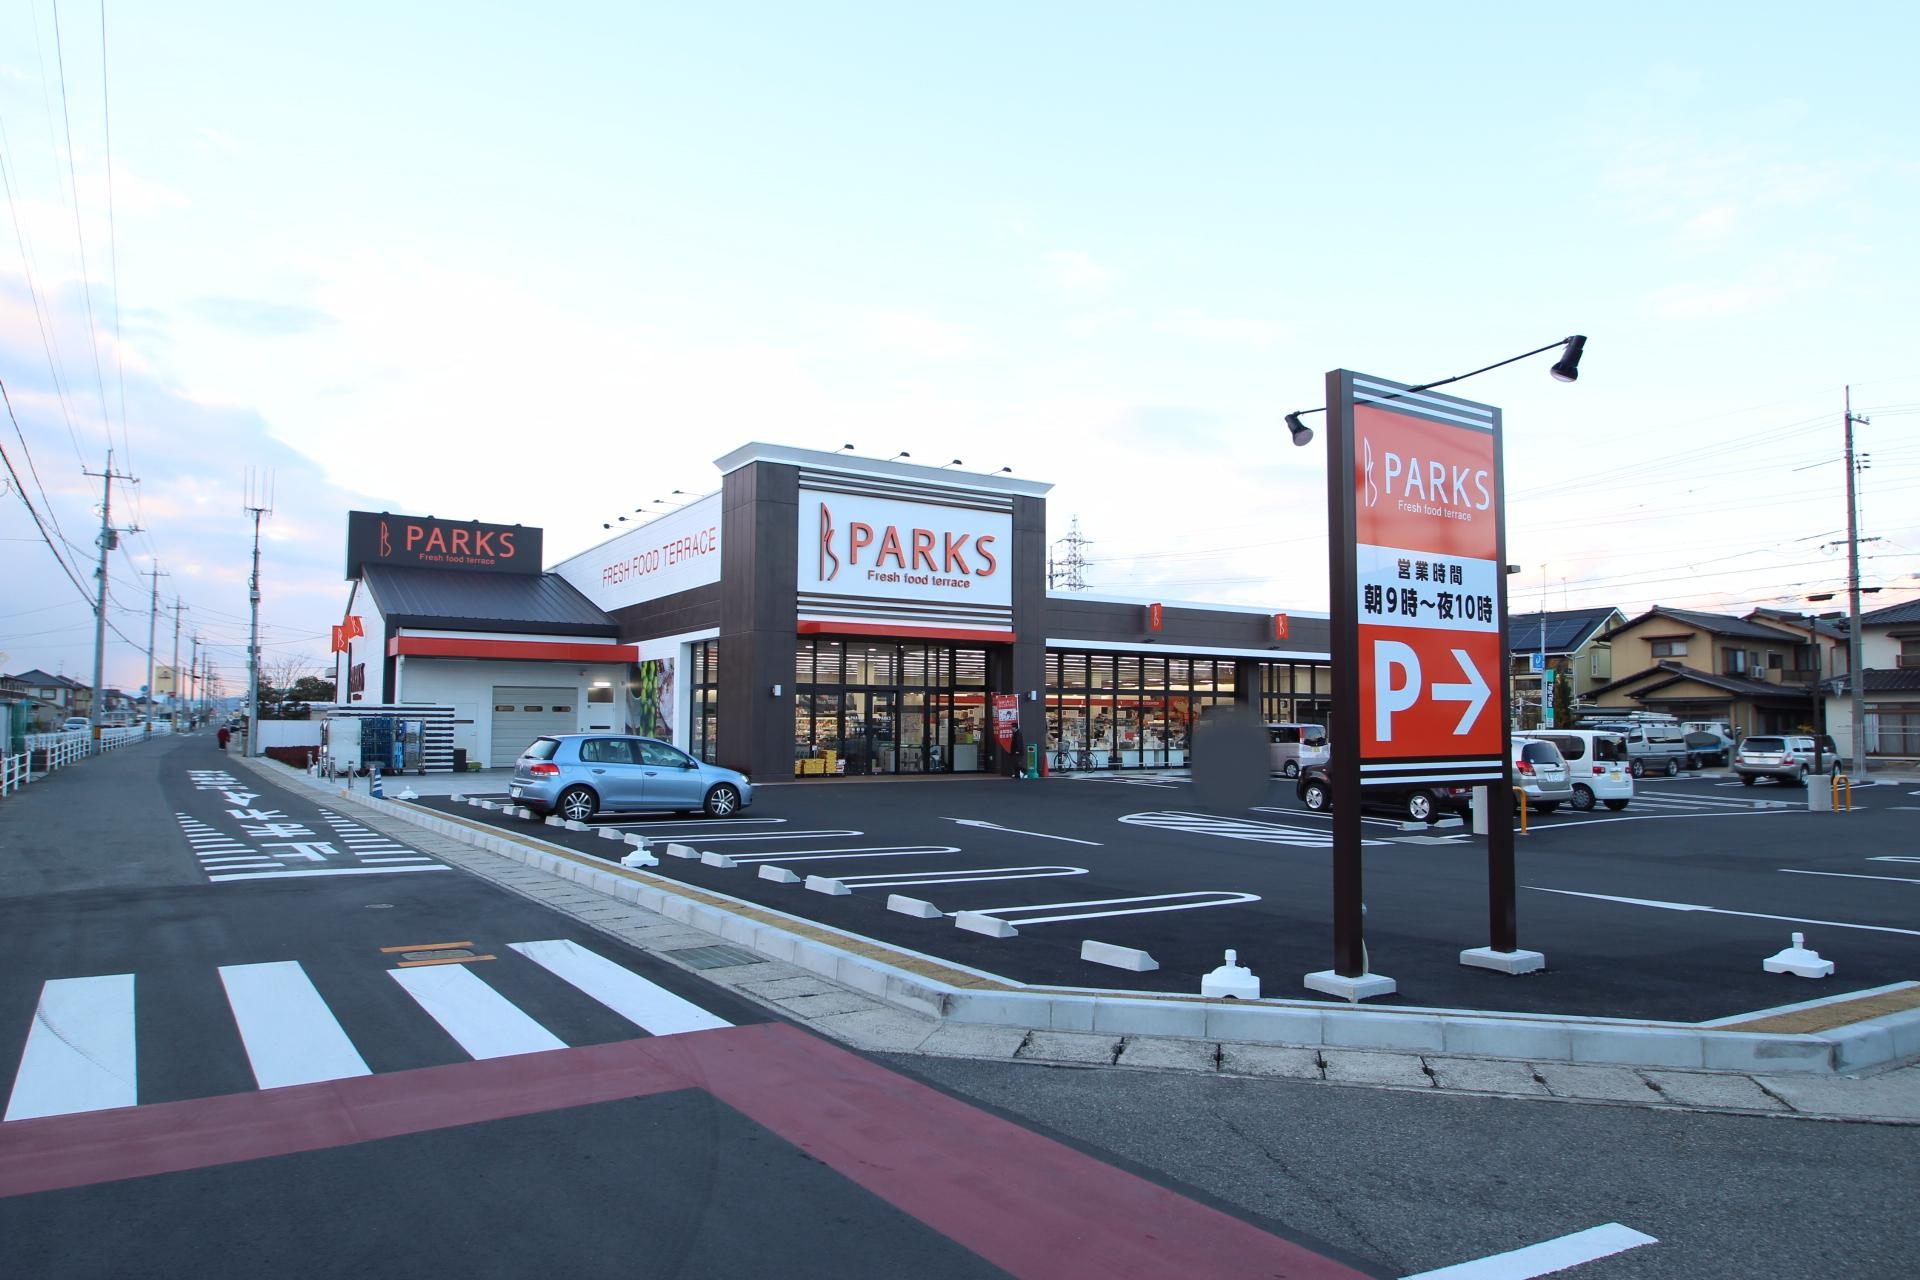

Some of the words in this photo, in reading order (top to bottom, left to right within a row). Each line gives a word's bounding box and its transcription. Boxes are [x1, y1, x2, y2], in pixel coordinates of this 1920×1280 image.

[1385, 451, 1490, 511] PARKS
[1398, 500, 1422, 514] Fresh
[1424, 504, 1442, 516] food
[1444, 509, 1472, 521] terrace
[406, 525, 515, 558] PARKS
[419, 553, 443, 562] Fresh
[446, 555, 464, 563] food
[466, 556, 496, 565] terrace
[602, 560, 630, 589] FRESH
[633, 549, 660, 577] FOOD
[662, 526, 717, 568] TERRACE
[849, 521, 997, 577] PARKS
[867, 569, 901, 583] Fresh
[904, 572, 929, 585] food
[932, 575, 971, 589] terrace
[1397, 558, 1463, 586] 営業時間
[1374, 639, 1422, 742] P
[225, 808, 341, 862] 止まれ
